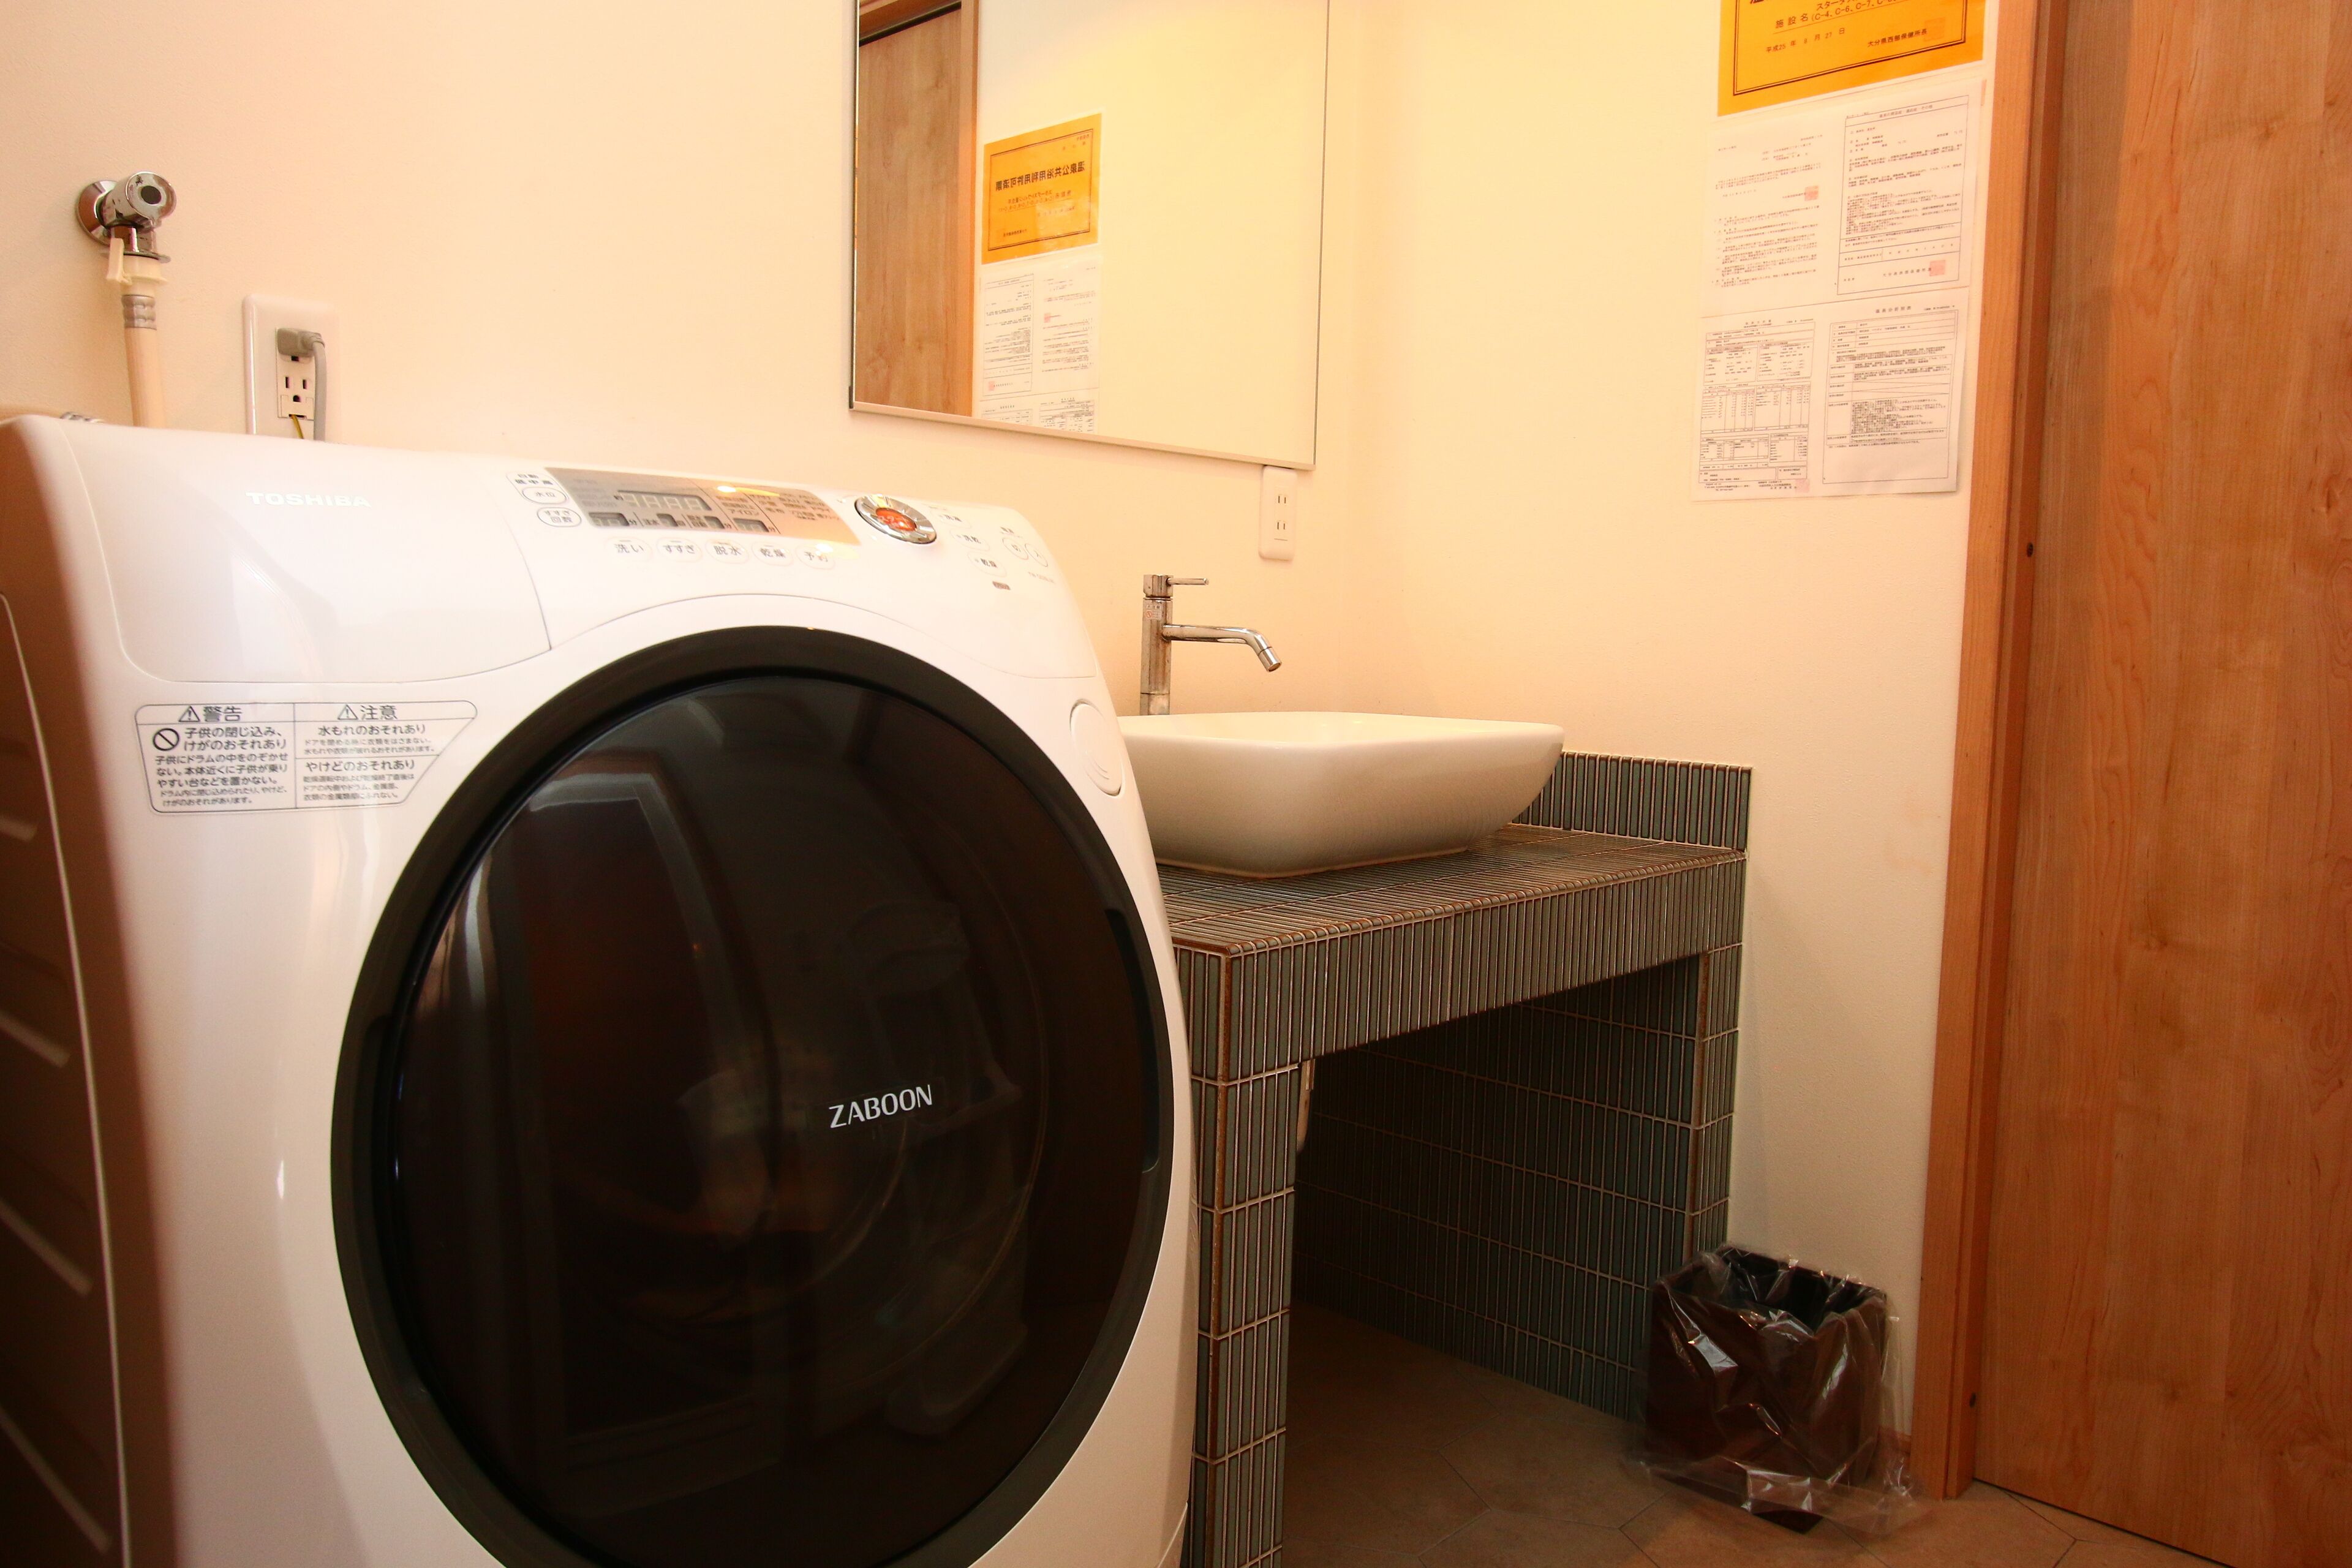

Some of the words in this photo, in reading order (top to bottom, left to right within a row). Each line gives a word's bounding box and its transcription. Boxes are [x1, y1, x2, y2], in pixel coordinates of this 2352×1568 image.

[246, 492, 372, 508] TOSHIBA
[615, 543, 644, 554] 洗い
[663, 544, 695, 554] すすぎ
[714, 545, 742, 556] 脱水
[203, 706, 243, 722] 警告
[360, 705, 398, 720] 注意
[184, 726, 282, 739] 子供の閉じ込み、
[318, 724, 426, 736] 水もれのおそれあり
[183, 739, 287, 752] けがのおそれあり
[155, 753, 288, 764] 子供にドラムの中をのぞかせ
[157, 764, 288, 776] ない。本体近くに子供が乗り
[306, 760, 415, 772] やけどのおそれあり
[157, 775, 277, 788] やすい台などを置かない。
[162, 797, 252, 807] けがのおそれがあります。
[829, 1084, 933, 1128] ZABOON
